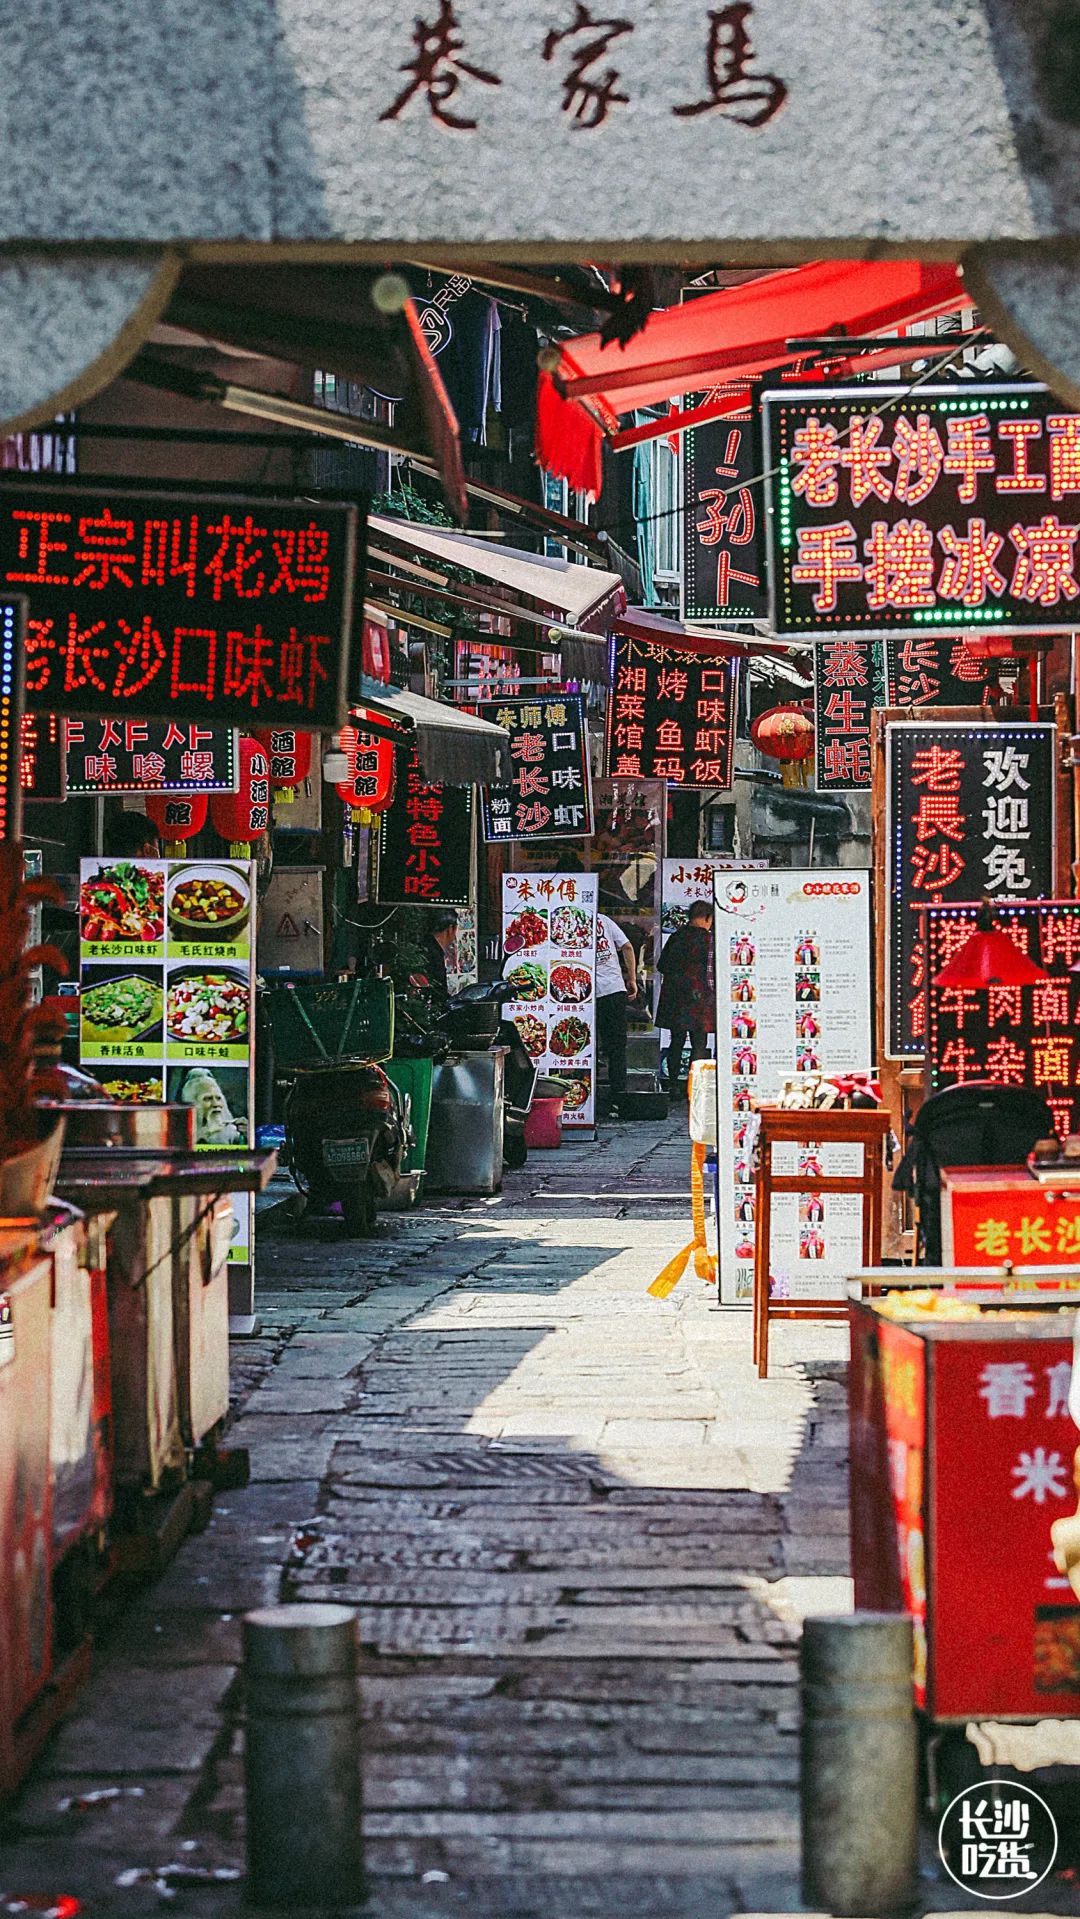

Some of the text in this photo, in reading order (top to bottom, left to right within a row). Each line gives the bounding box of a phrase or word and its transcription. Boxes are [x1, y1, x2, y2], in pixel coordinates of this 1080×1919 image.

[790, 414, 1080, 506] 老长沙手工面
[6, 508, 330, 602] 正宗叫花鸡
[792, 515, 1080, 613] 手搓冰凉
[496, 703, 567, 730] 朱师傅
[823, 641, 869, 783] 蒸生蚝
[511, 732, 552, 832] 老长沙
[551, 731, 584, 827] 口味虾
[982, 746, 1031, 902] 欢迎免
[517, 878, 579, 902] 朱师傅
[683, 886, 713, 899] 老长沙
[88, 944, 157, 956] 老长沙口味虾
[179, 944, 237, 957] 毛氏红烧肉
[508, 1004, 545, 1012] 农家小炒肉
[938, 979, 1080, 1026] 牛肉面
[100, 1045, 145, 1057] 香辣活鱼
[184, 1045, 229, 1058] 口味牛蛙
[552, 1059, 589, 1067] 小炒黄牛肉
[938, 1036, 1080, 1086] 牛杂面
[974, 1216, 1080, 1256] 老长沙
[1011, 1447, 1068, 1503] 米
